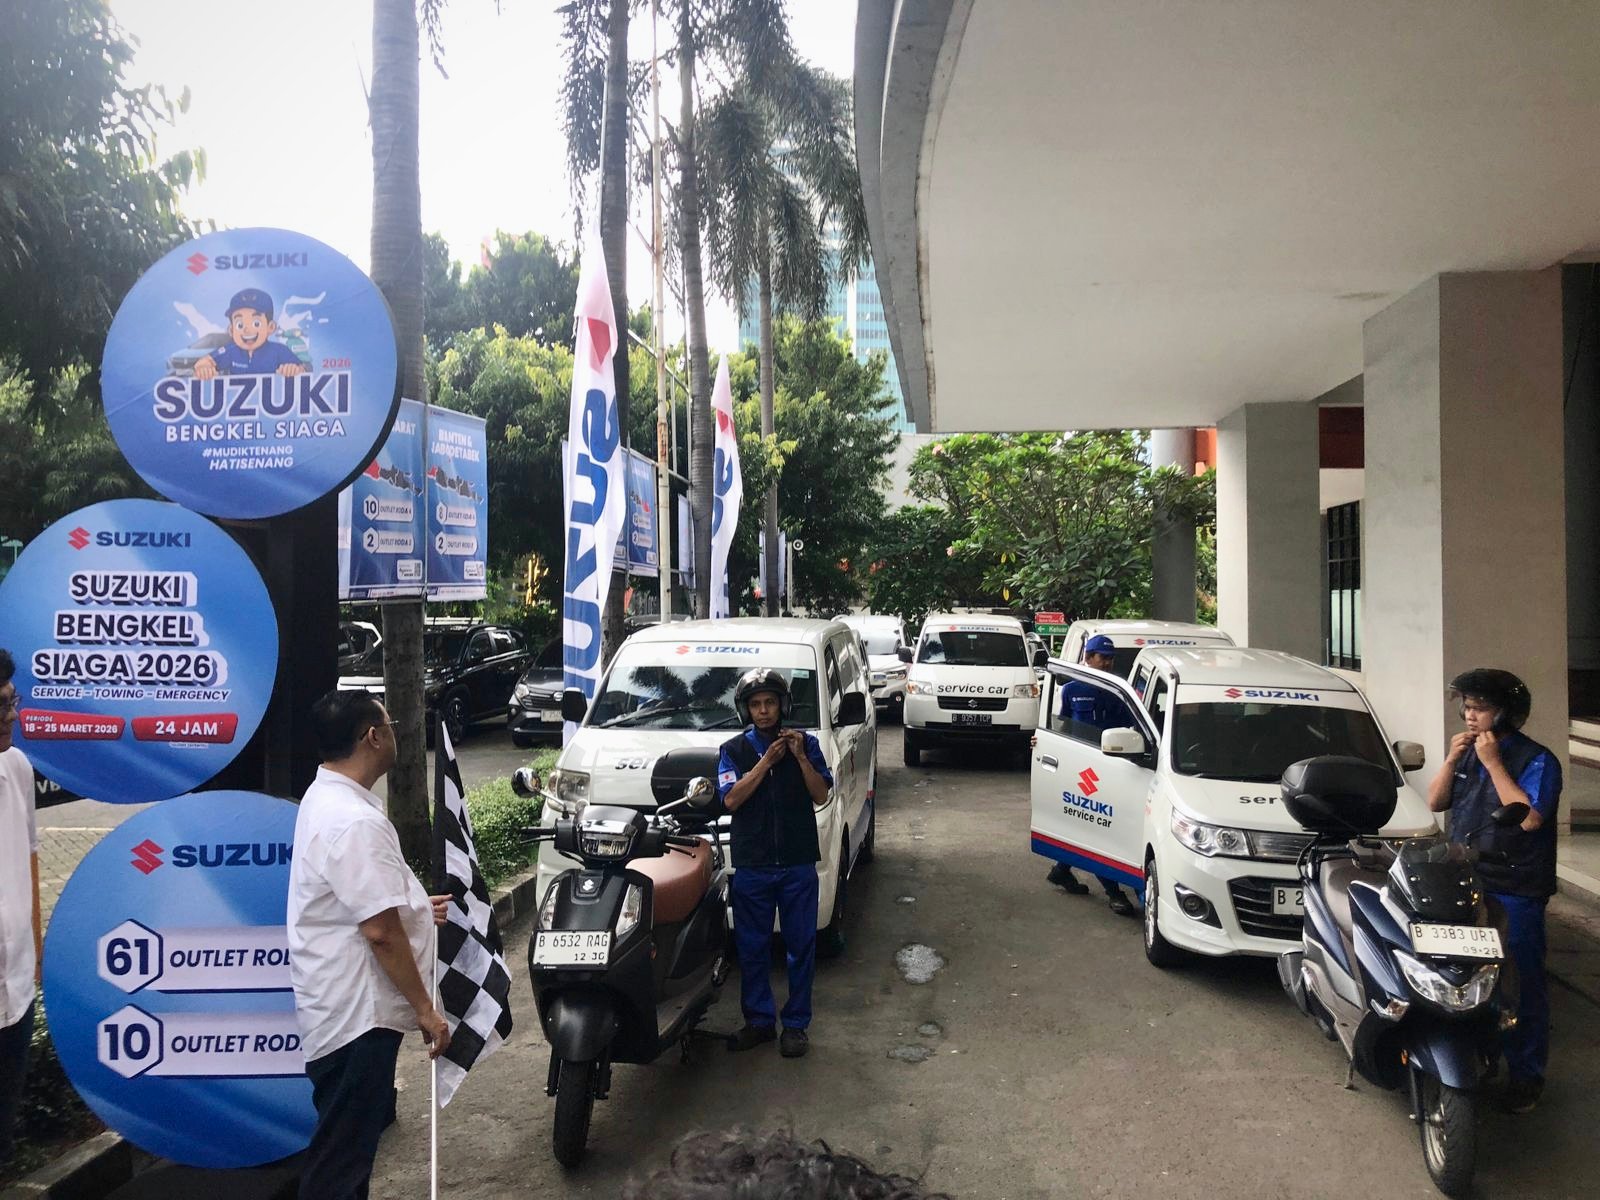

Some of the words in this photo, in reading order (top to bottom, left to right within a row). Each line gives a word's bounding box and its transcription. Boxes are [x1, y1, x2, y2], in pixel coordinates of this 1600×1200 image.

[214, 253, 308, 270] SUZUKI
[156, 374, 349, 420] SUZUKI
[166, 422, 266, 442] BENGKEL
[275, 420, 346, 438] SIAGA
[202, 445, 293, 458] #MUDIKTENANG
[209, 457, 294, 470] HATISENANG
[365, 500, 377, 514] 10
[96, 531, 191, 547] SUZUKI
[367, 533, 375, 548] 2
[438, 536, 444, 550] 2
[71, 574, 181, 600] SUZUKI
[56, 614, 193, 639] BENGKEL
[695, 646, 760, 655] SUZUKI
[34, 653, 132, 678] SIAGA
[137, 654, 212, 680] 2026
[32, 687, 82, 698] SERVICE
[94, 689, 144, 699] TOWING
[155, 690, 230, 700] EMERGENCY
[937, 683, 984, 694] service
[988, 685, 1010, 695] car
[1244, 689, 1319, 702] SUZUKI
[25, 723, 35, 732] 18
[45, 723, 57, 732] 25
[60, 724, 93, 733] MARET
[95, 724, 118, 734] 2026
[155, 721, 176, 736] 24
[1062, 791, 1113, 817] SUZUKI
[1239, 796, 1282, 805] ser
[1063, 805, 1095, 823] service
[1096, 816, 1112, 828] car
[1277, 889, 1286, 905] B
[1414, 926, 1423, 938] B
[1431, 927, 1465, 940] 3383
[539, 935, 546, 948] B
[552, 934, 581, 948] 6532
[586, 934, 609, 948] RAG
[106, 938, 150, 976] 61
[169, 949, 249, 968] OUTLET
[574, 953, 586, 961] 12
[104, 1024, 150, 1061] 10
[171, 1035, 250, 1054] OUTLET
[253, 1033, 303, 1053] ROD
